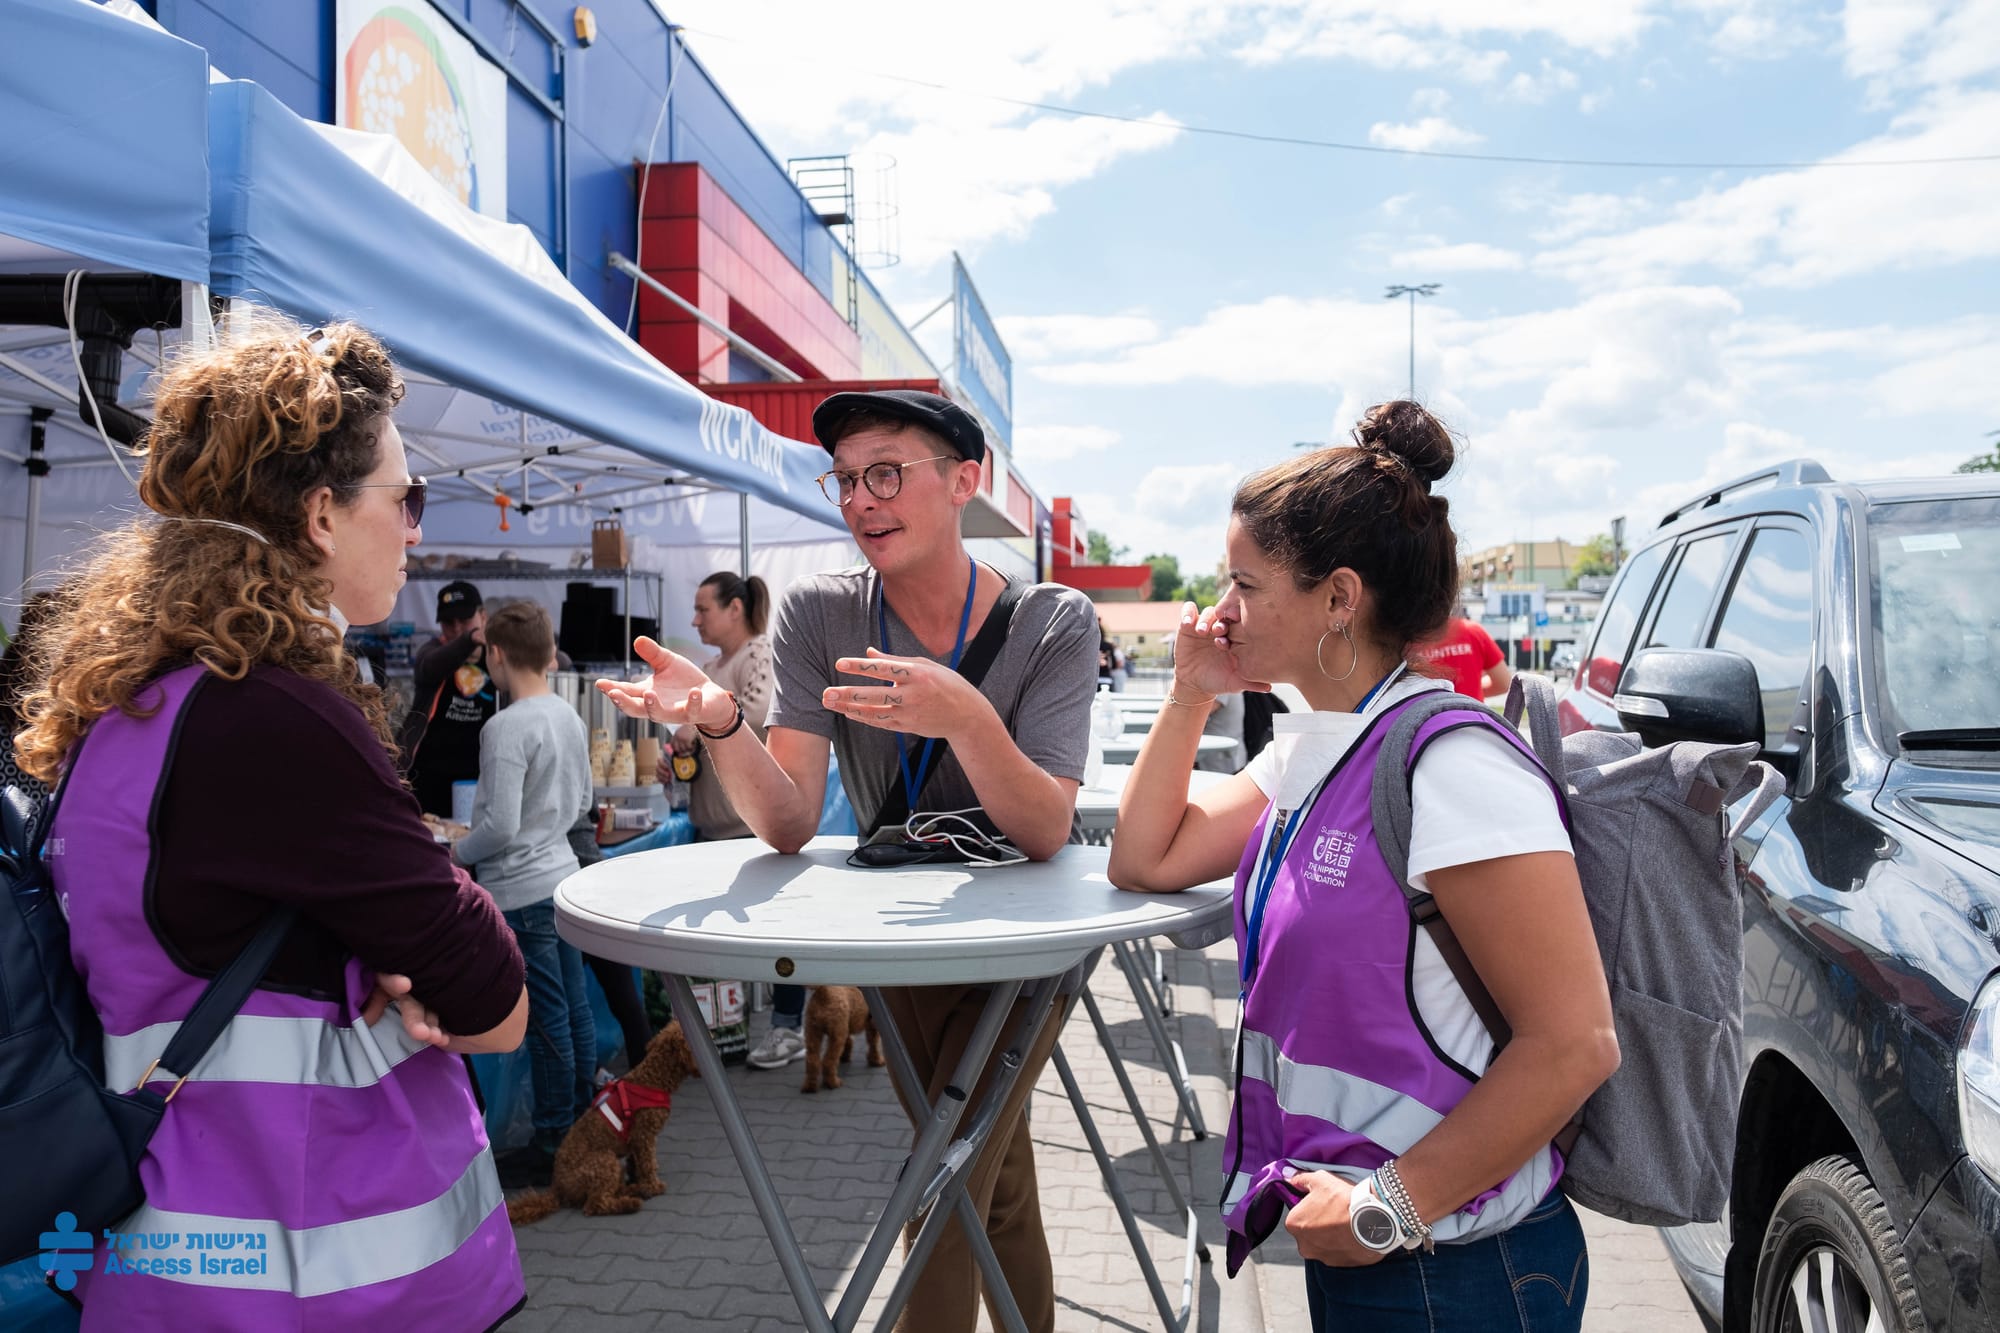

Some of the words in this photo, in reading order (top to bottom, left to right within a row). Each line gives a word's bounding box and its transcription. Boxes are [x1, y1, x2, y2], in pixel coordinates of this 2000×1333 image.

[700, 401, 788, 494] WCK.org
[1418, 644, 1473, 659] LUNTEER
[1328, 837, 1356, 854] 日本
[1348, 833, 1359, 842] by
[1303, 870, 1345, 888] FOUNDATION
[1317, 864, 1347, 879] NIPPON
